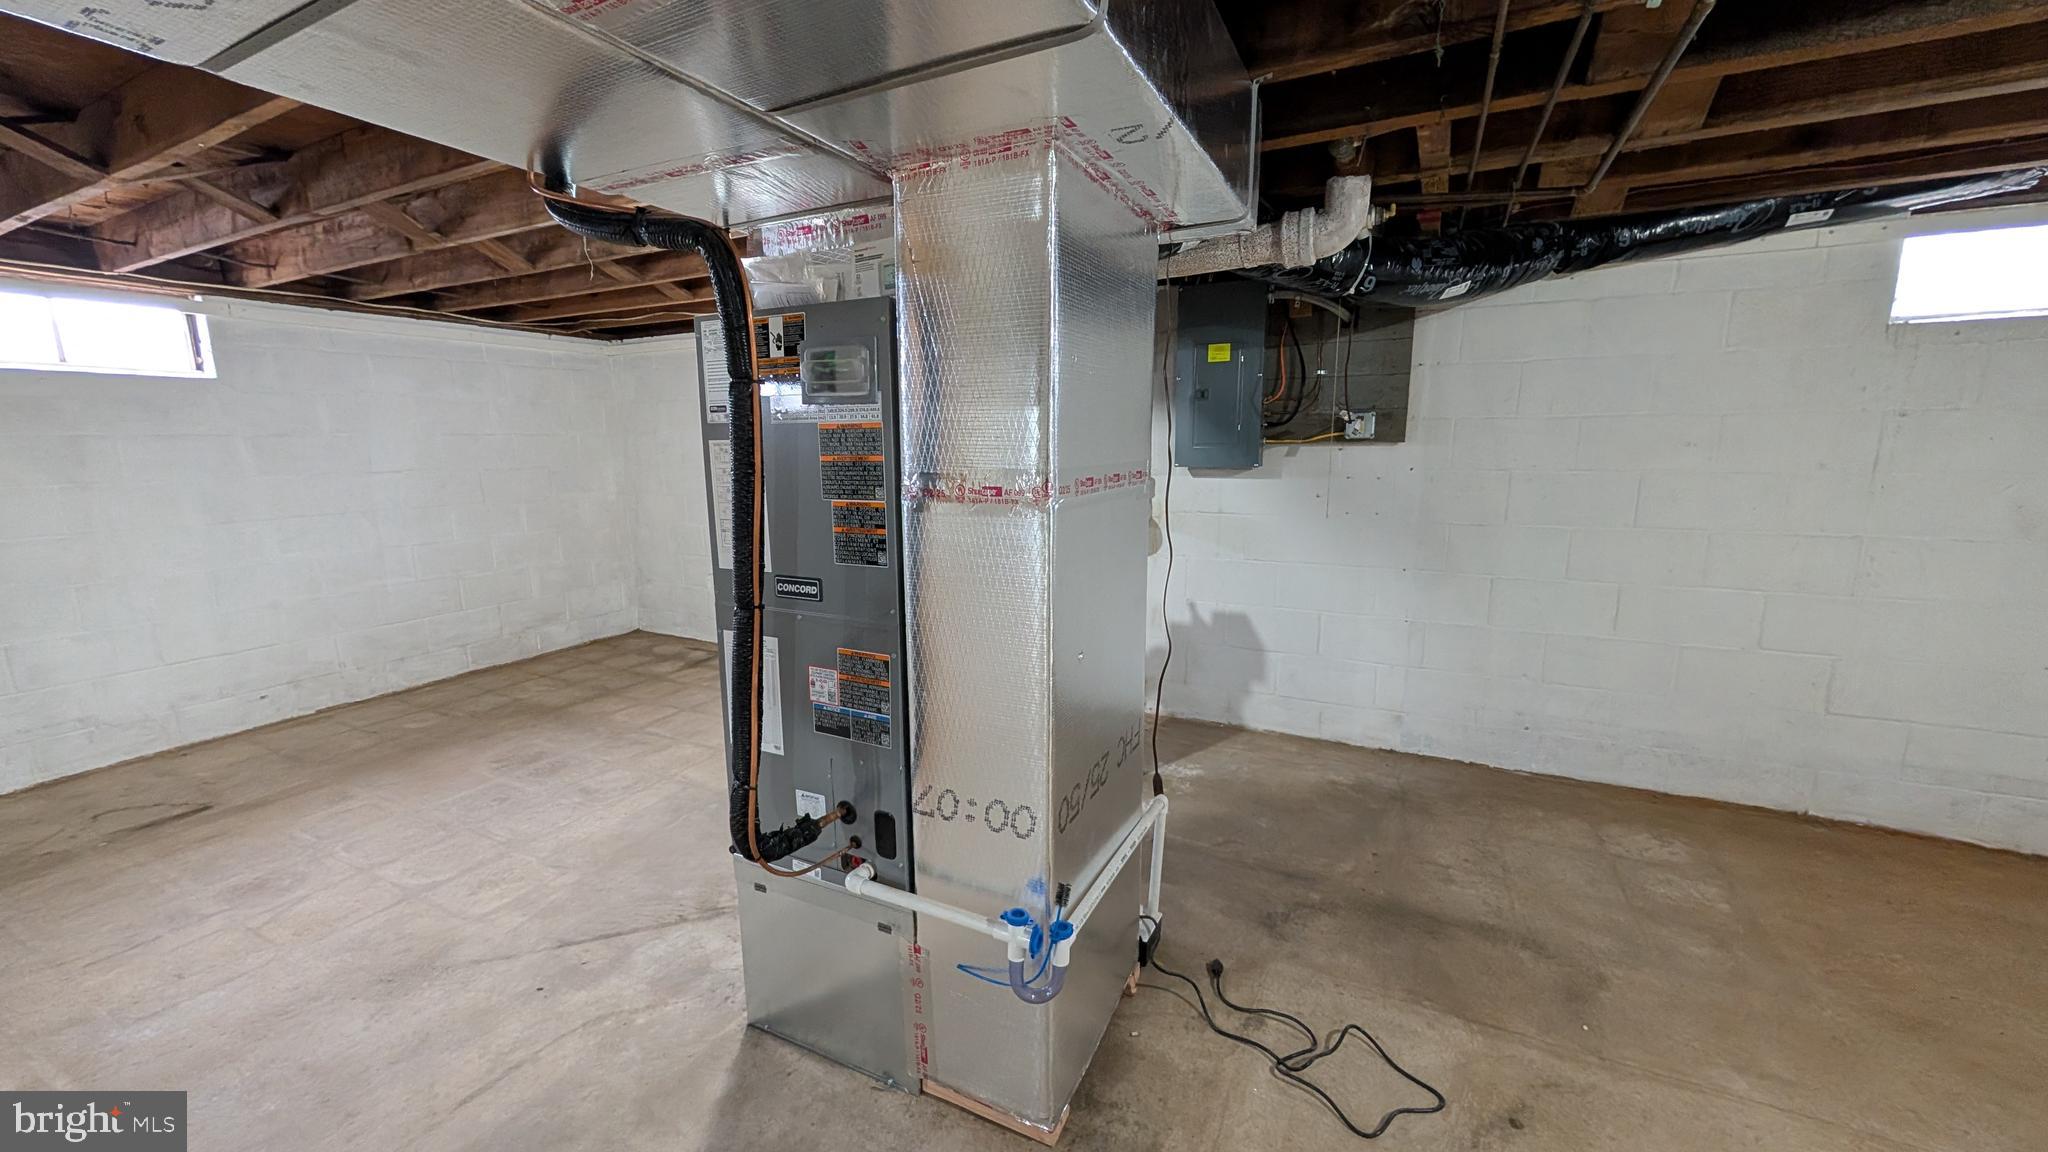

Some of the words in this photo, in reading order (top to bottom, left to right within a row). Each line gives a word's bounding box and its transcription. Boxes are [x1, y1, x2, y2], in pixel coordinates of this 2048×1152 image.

[776, 582, 819, 595] CONCORD
[912, 784, 1038, 841] 00:07
[1057, 750, 1111, 835] 25/50
